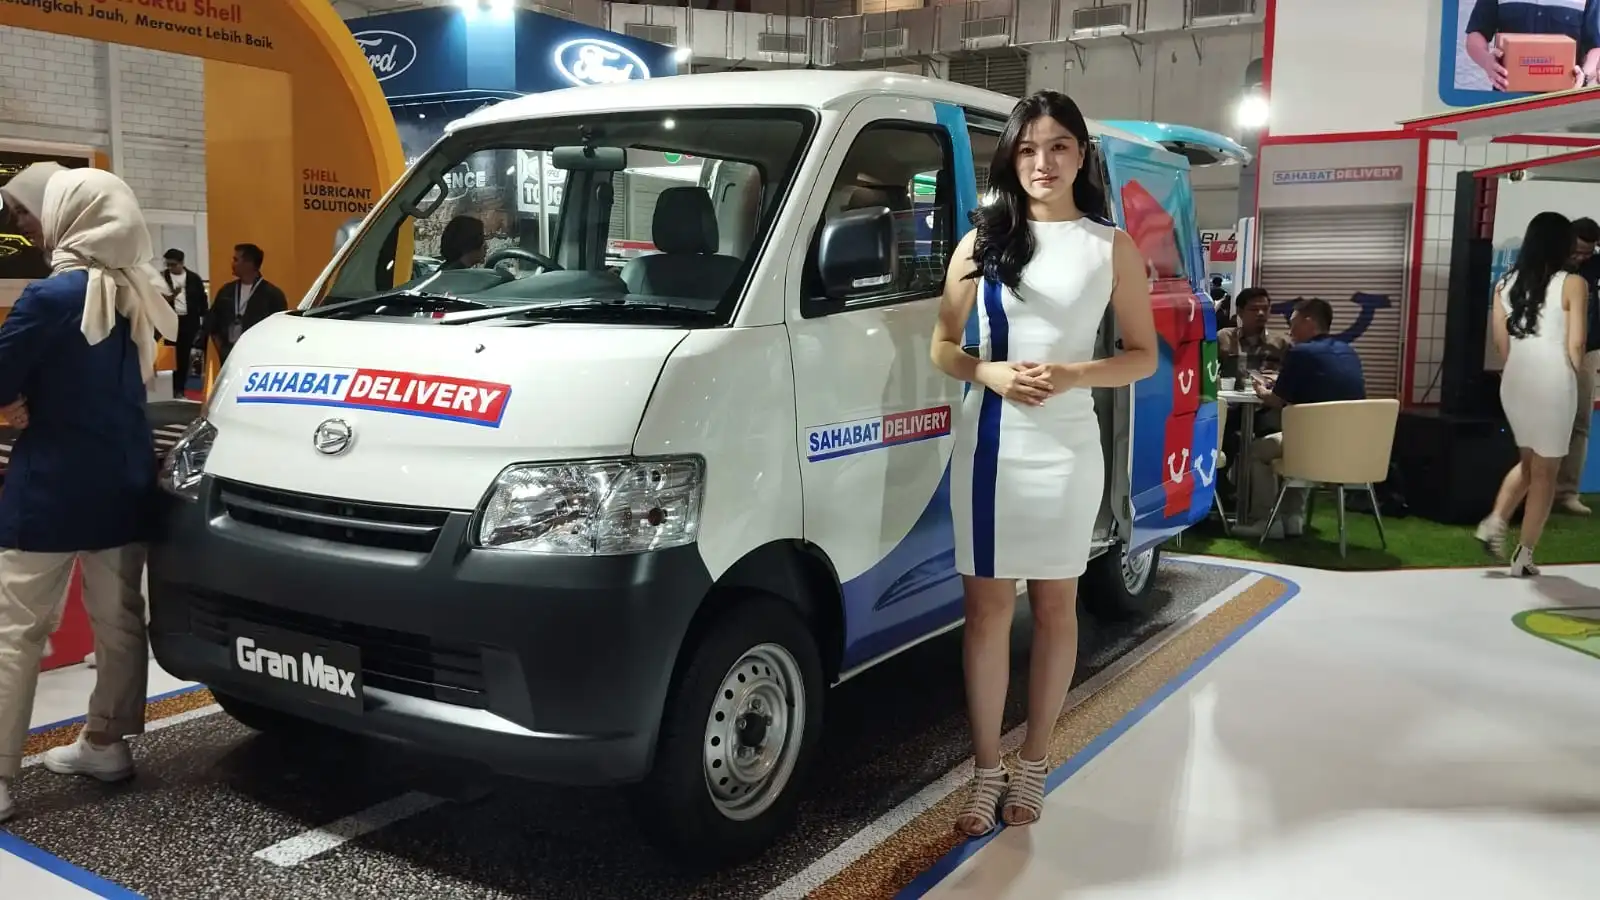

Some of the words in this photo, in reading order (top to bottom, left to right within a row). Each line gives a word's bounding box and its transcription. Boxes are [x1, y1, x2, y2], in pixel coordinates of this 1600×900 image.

[194, 0, 242, 24] Shell
[87, 5, 128, 24] Jauh,
[135, 14, 203, 37] Merawat
[206, 26, 242, 44] Lebih
[245, 33, 274, 50] Baik
[302, 168, 340, 183] SHELL
[442, 170, 486, 190] ENCE
[1275, 170, 1332, 182] SAHABAT
[1335, 166, 1400, 180] DELIVERY
[303, 183, 372, 200] LUBRICANT
[303, 198, 374, 214] SOLUTIONS
[244, 372, 350, 395] SAHABAT
[350, 374, 501, 414] DELIVERY
[809, 422, 881, 452] SAHABAT
[884, 411, 948, 438] DELIVERY
[236, 636, 299, 683] Gran
[302, 652, 356, 698] Max
